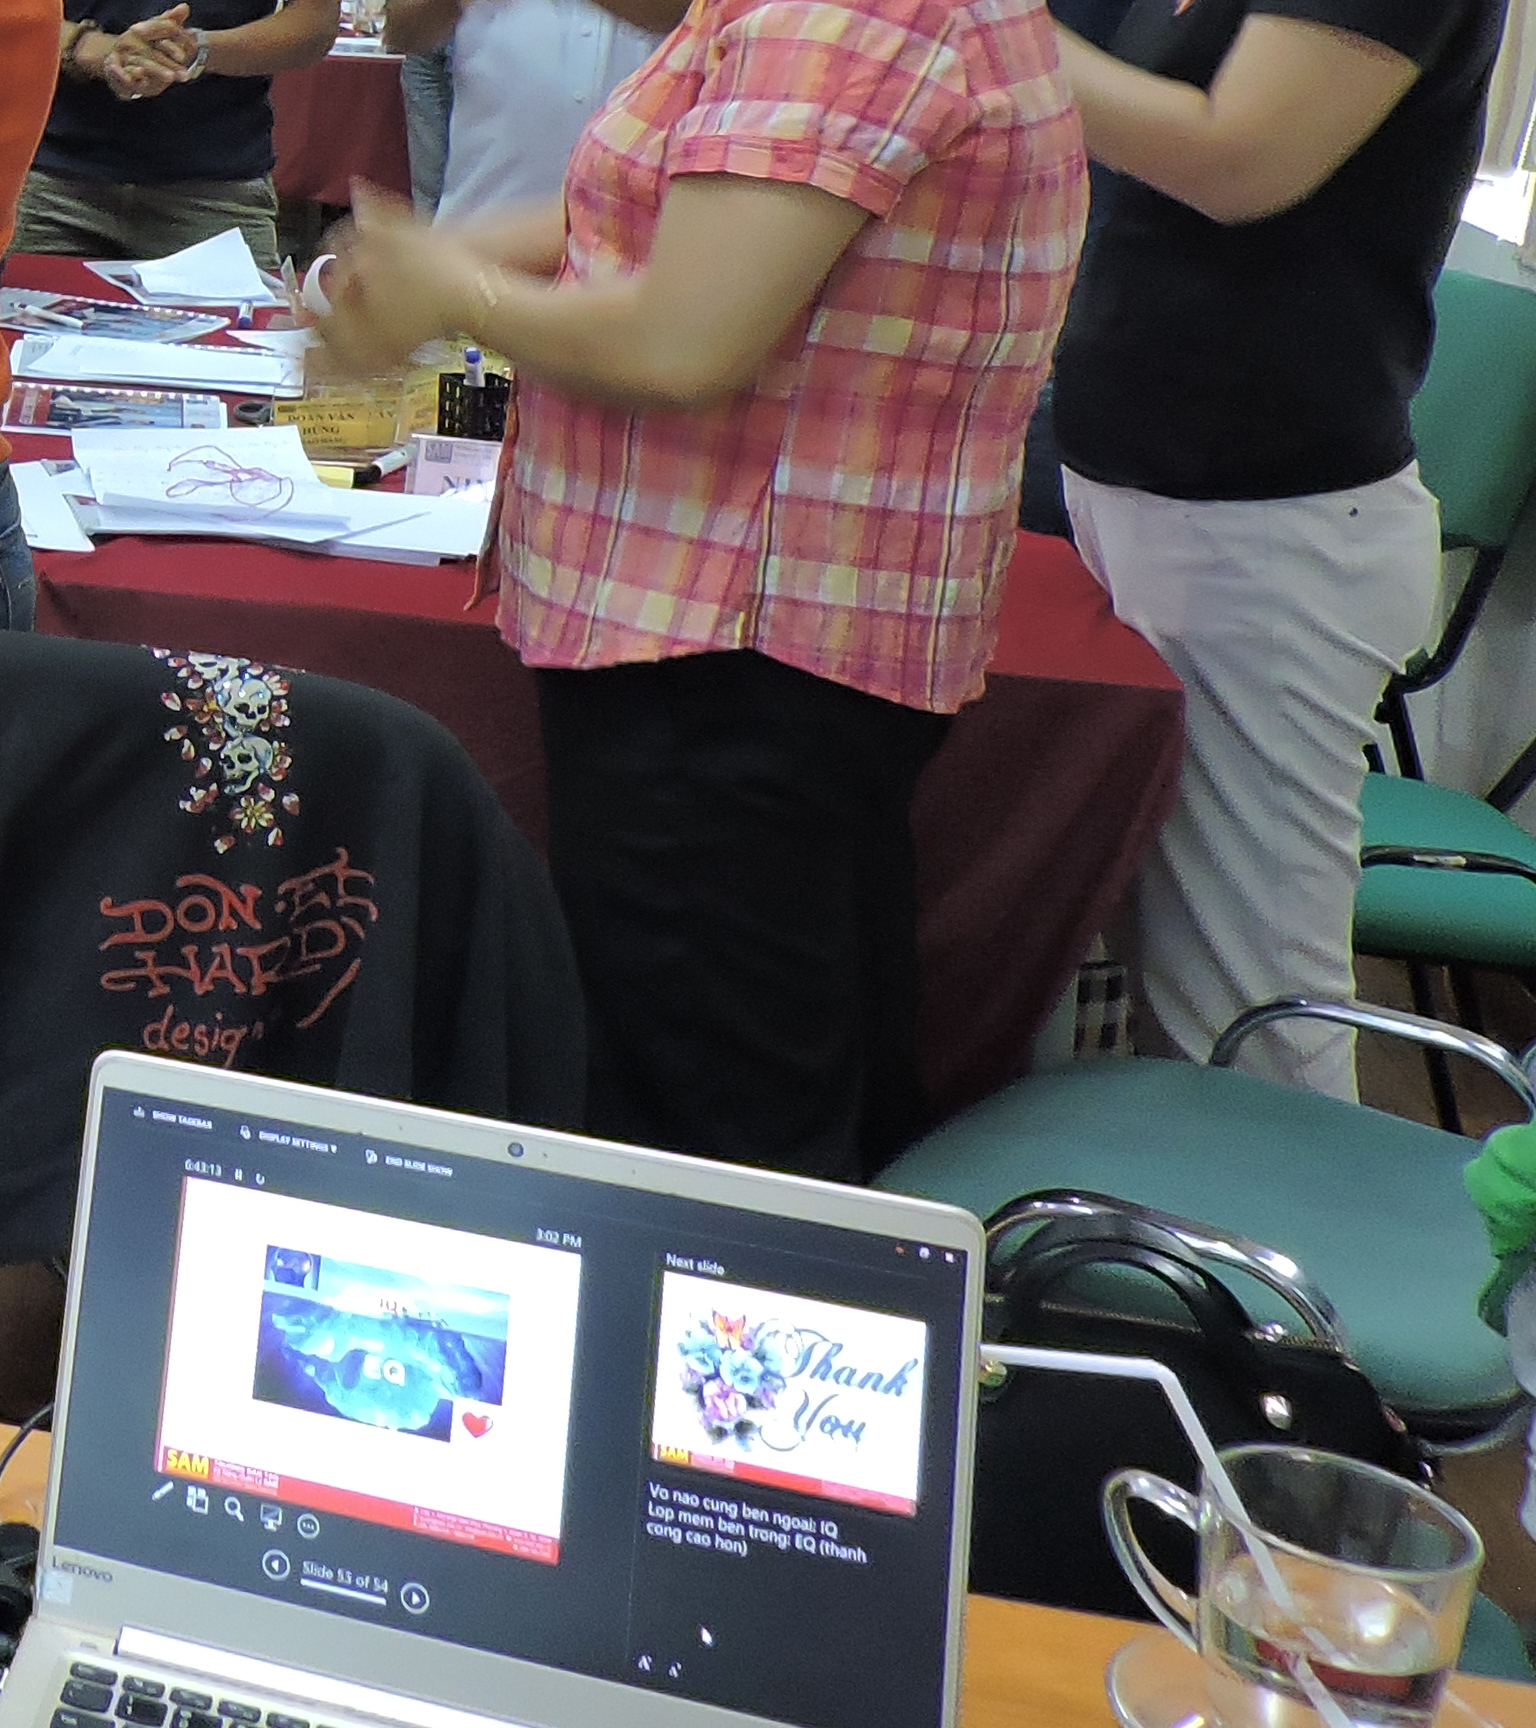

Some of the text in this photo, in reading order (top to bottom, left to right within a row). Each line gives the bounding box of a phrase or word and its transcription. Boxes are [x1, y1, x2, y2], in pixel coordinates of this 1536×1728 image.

[562, 1233, 583, 1249] PM
[666, 1252, 726, 1276] Next slide
[770, 1322, 919, 1397] Thank
[770, 1388, 866, 1450] You
[166, 1448, 210, 1476] SAM
[648, 1480, 670, 1500] Vo
[672, 1490, 699, 1508] nao
[702, 1496, 738, 1520] cung
[741, 1502, 770, 1523] ben
[820, 1520, 839, 1540] IQ
[646, 1521, 683, 1545] cong
[685, 1528, 712, 1548] cao
[647, 1501, 675, 1521] Lop
[677, 1511, 715, 1530] mem
[717, 1515, 746, 1537] ben
[794, 1532, 818, 1554] EQ
[819, 1538, 868, 1565] (thanh
[302, 1559, 334, 1581] Slide
[355, 1570, 371, 1588] of
